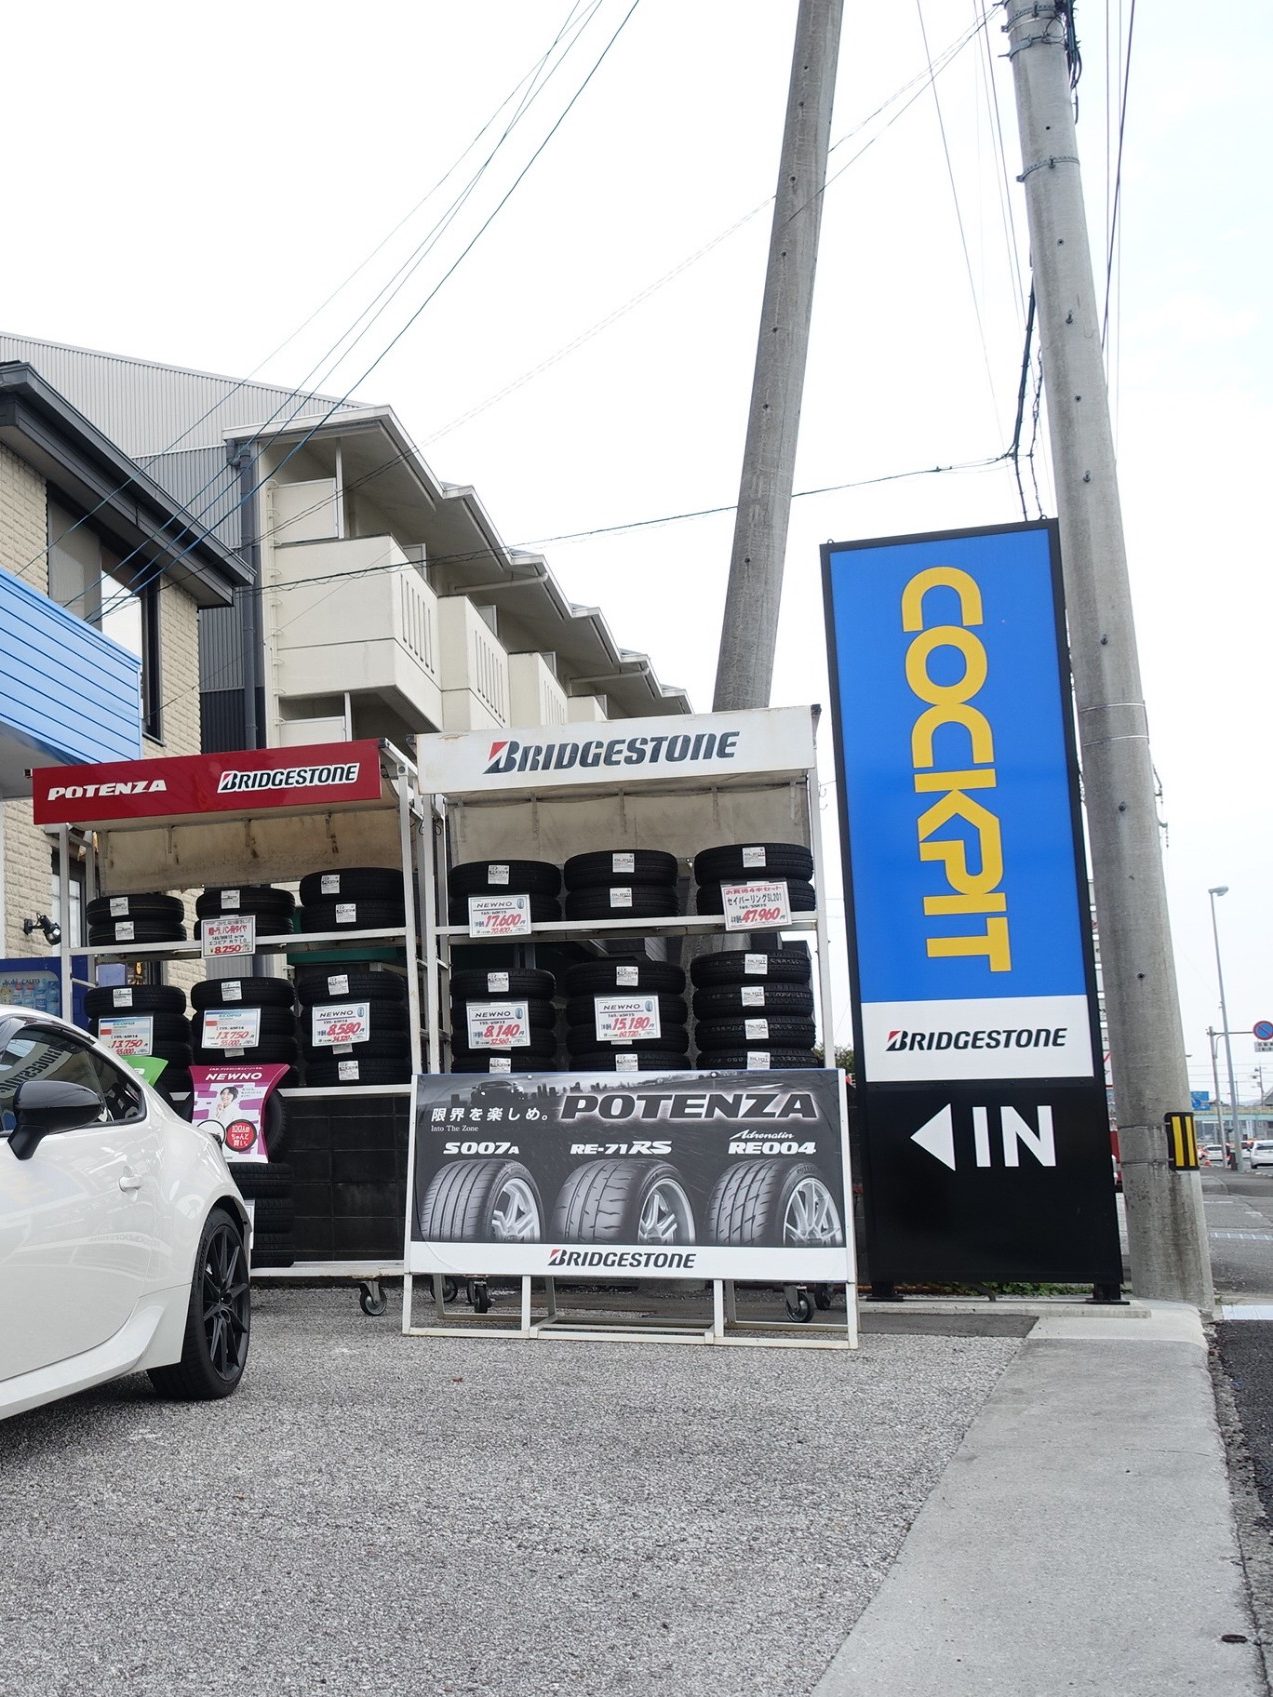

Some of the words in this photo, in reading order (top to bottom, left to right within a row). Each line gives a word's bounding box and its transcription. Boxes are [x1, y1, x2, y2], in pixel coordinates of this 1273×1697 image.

[483, 731, 739, 774] BRIDGESTONE
[900, 565, 1013, 973] COCKPIT
[47, 778, 167, 802] POTENZA
[218, 763, 360, 793] BRIDGESTONE
[476, 901, 513, 909] NEWNO
[319, 1010, 353, 1018] NEWNO
[603, 1003, 641, 1011] NEWNO
[885, 1027, 1068, 1053] BRIDGESTONE
[205, 1072, 263, 1081] NEWNO
[560, 1093, 818, 1119] POTENZA
[430, 1107, 548, 1122] 限界を楽しめ。
[729, 1128, 795, 1140] Adrenalin
[972, 1104, 1057, 1168] IN
[443, 1141, 520, 1155] S007A
[570, 1140, 673, 1155] RE-71RS
[728, 1141, 817, 1155] RE004
[547, 1249, 697, 1269] BRIDGESTONE
